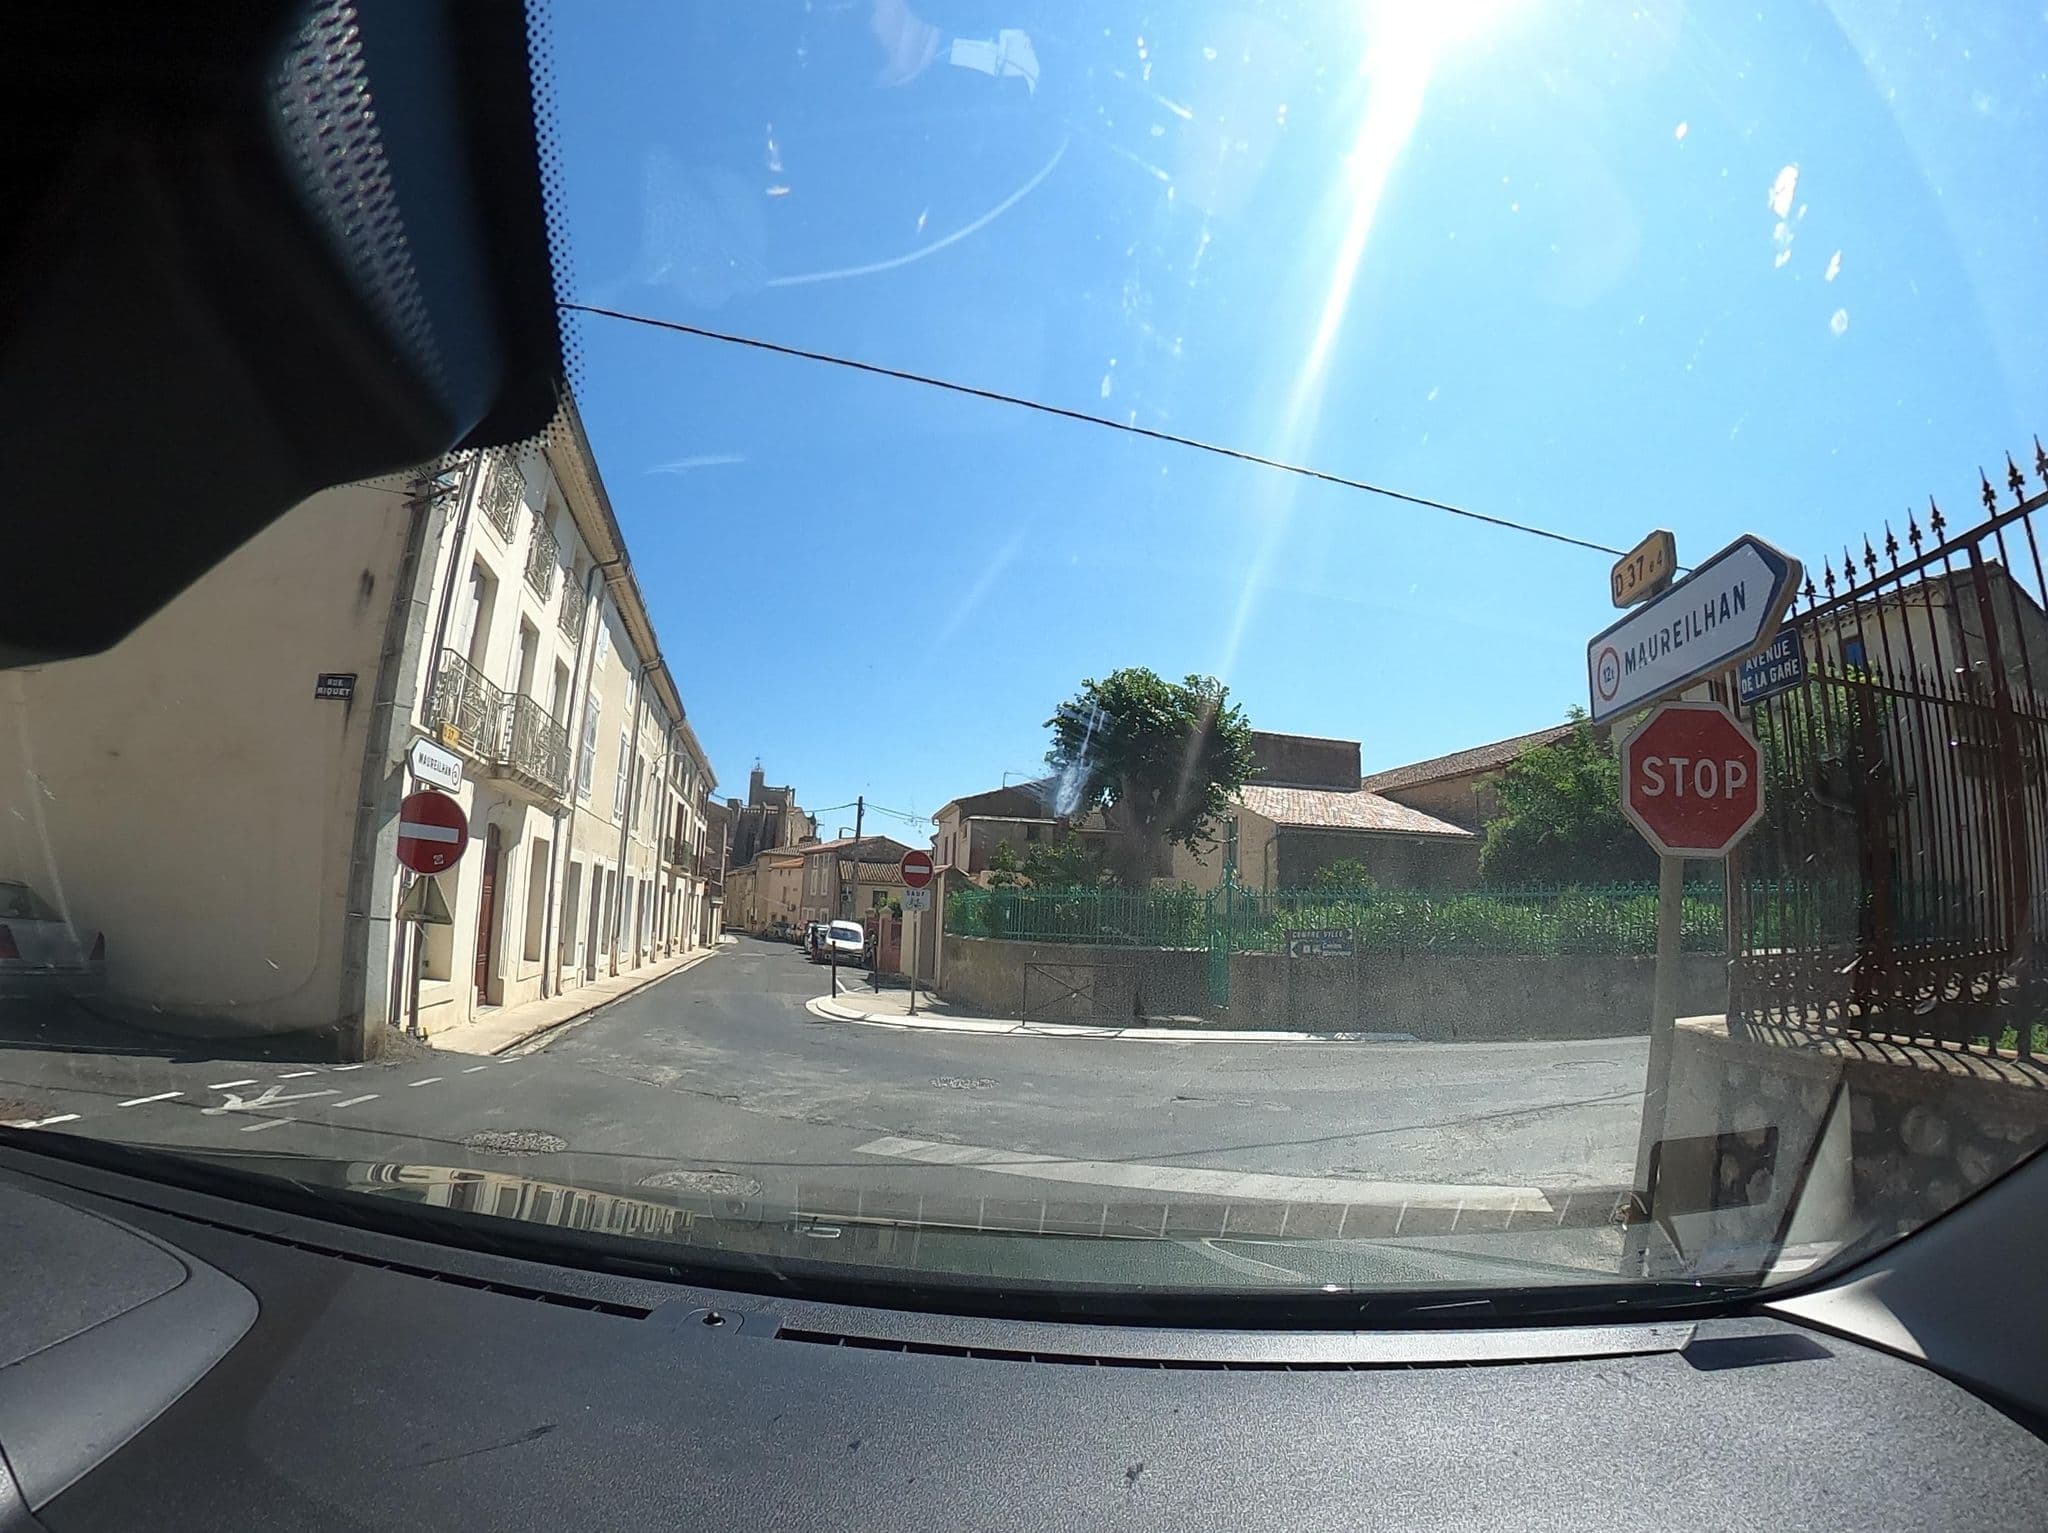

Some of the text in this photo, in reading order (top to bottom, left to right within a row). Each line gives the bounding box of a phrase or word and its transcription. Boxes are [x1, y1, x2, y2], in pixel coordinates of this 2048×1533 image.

[1616, 573, 1624, 598] D
[1627, 555, 1645, 588] 37
[1624, 580, 1746, 676] MAUREILHAN
[1745, 640, 1791, 672] AVENUE
[1741, 658, 1800, 694] DE LA GARE
[418, 751, 452, 777] MAUREILHAN
[1641, 756, 1748, 800] STOP
